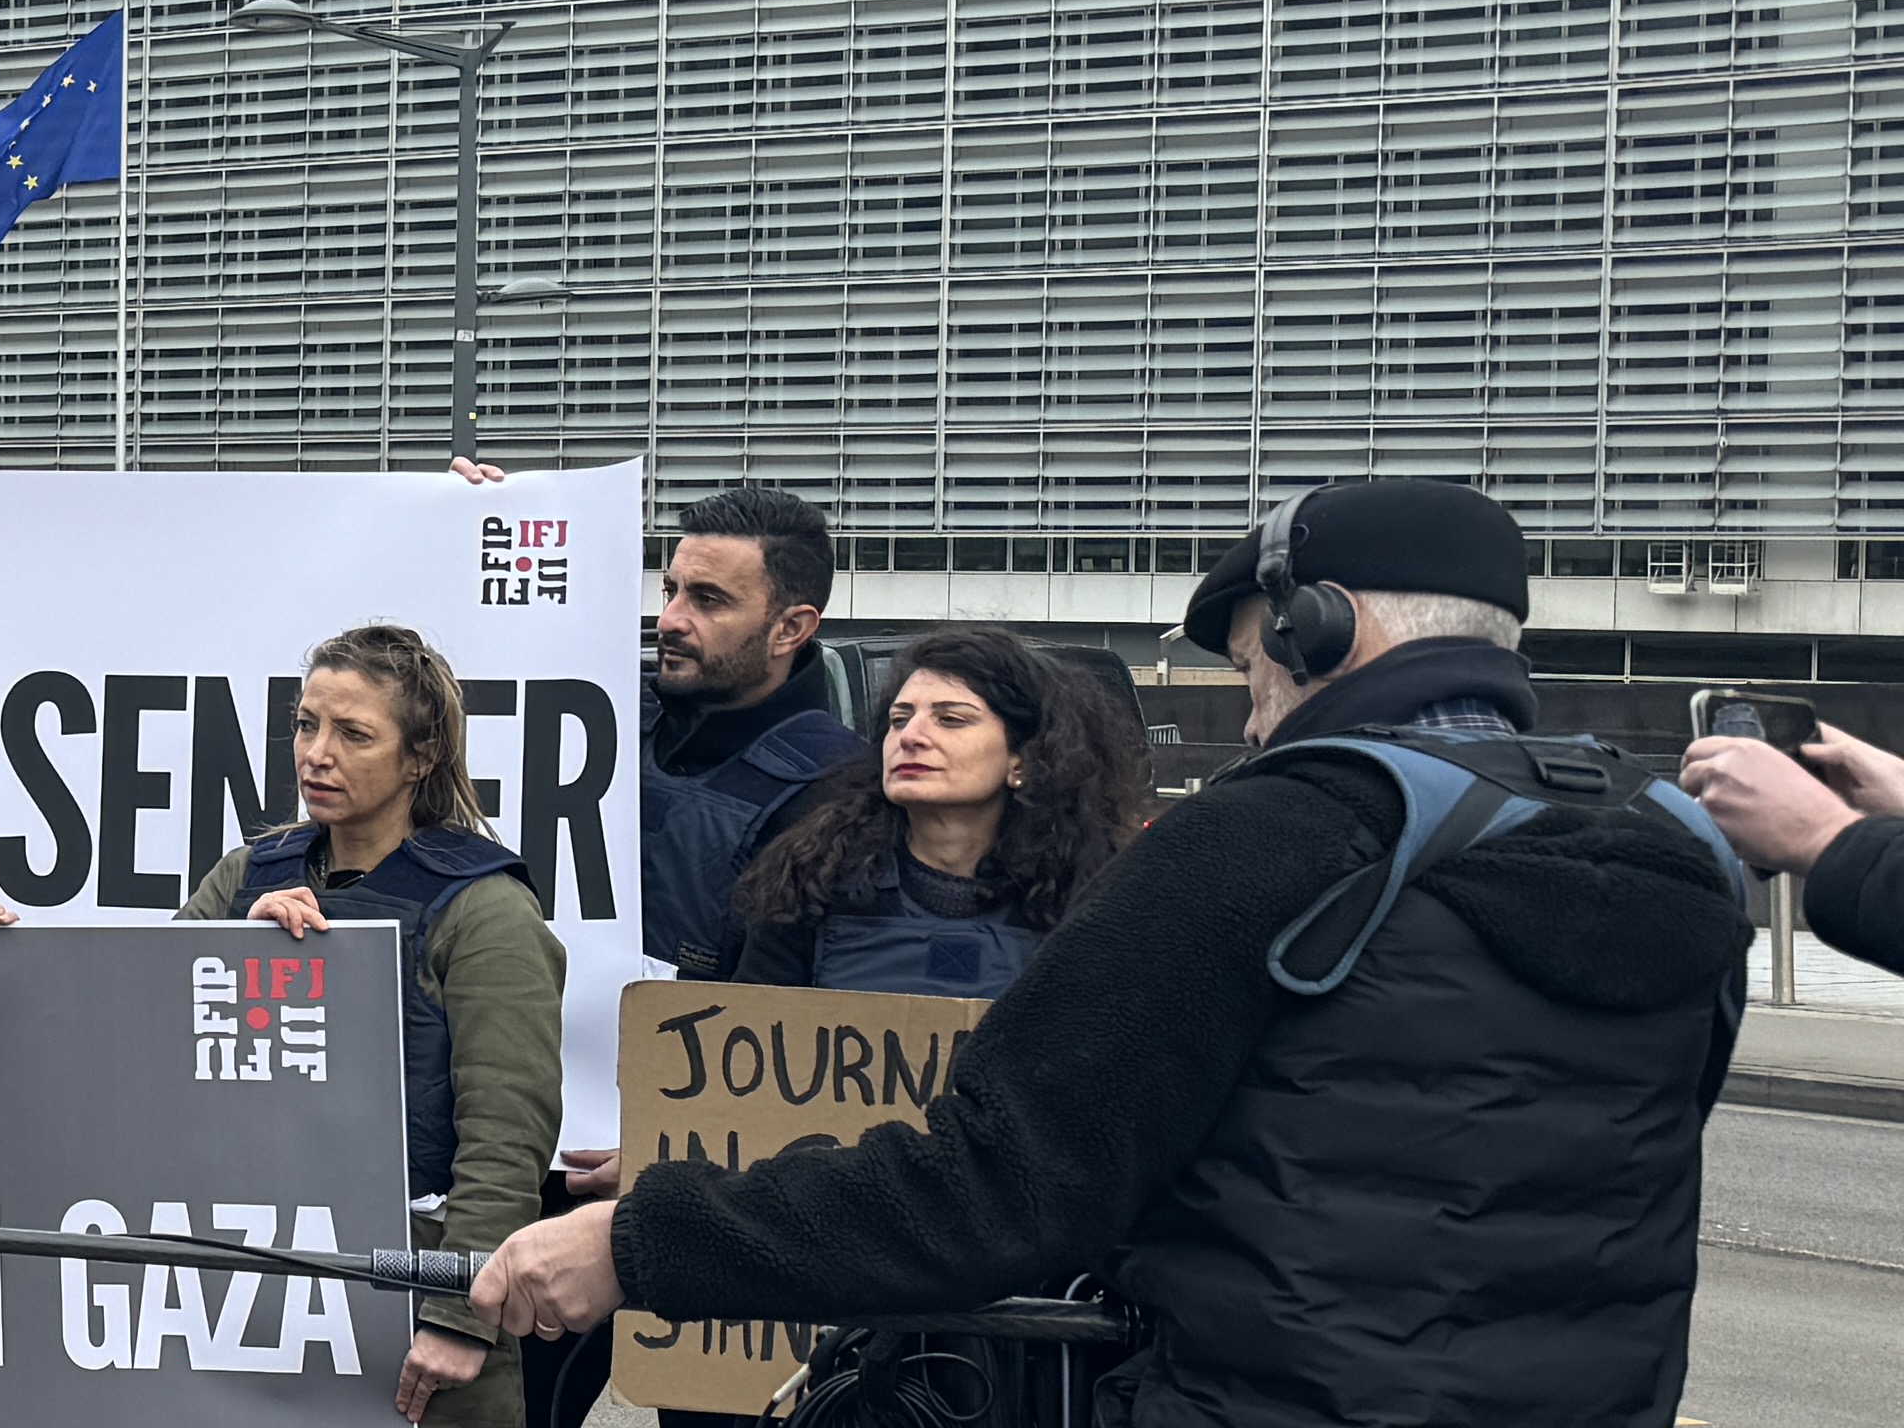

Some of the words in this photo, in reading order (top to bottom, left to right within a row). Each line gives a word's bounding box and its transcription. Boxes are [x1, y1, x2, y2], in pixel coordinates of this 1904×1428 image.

[518, 520, 568, 547] IFJ
[243, 957, 326, 999] IFJ
[59, 1199, 363, 1377] GAZA
